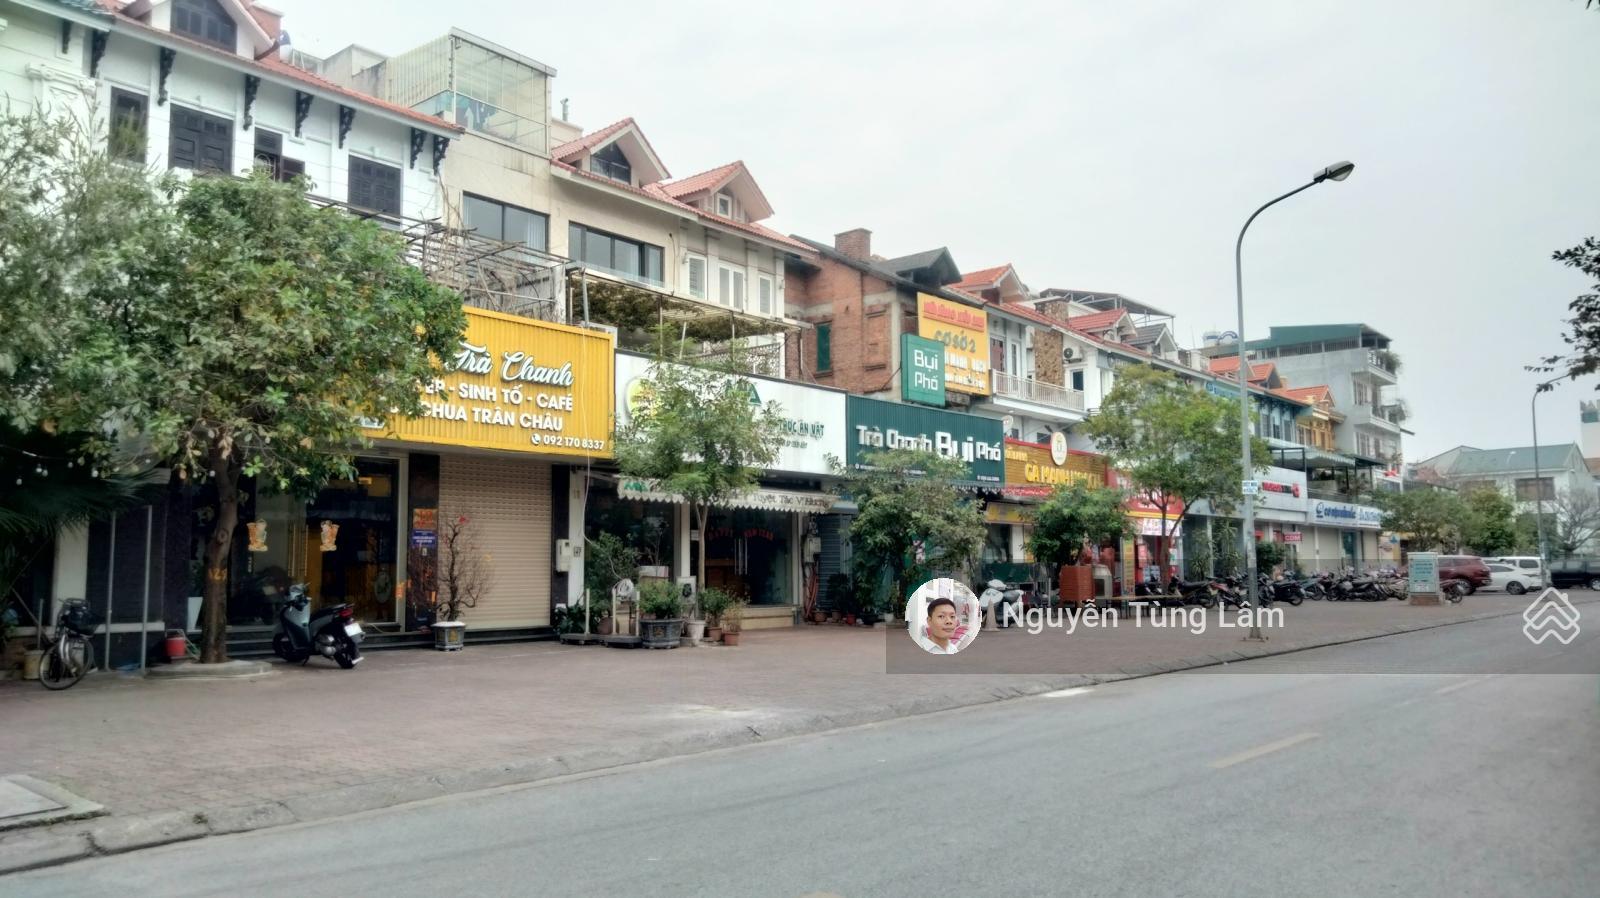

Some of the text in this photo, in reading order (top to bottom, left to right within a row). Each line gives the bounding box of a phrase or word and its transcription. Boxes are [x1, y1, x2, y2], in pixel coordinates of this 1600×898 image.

[501, 351, 575, 387] Chanh
[914, 349, 938, 372] Bụi
[914, 375, 938, 391] Phố
[458, 382, 497, 402] SINH
[501, 384, 523, 405] TỐ
[536, 393, 573, 412] CAFÉ
[471, 407, 515, 427] TRÂN
[519, 411, 563, 431] CHÂU
[543, 434, 605, 450] 092 170 8337
[856, 425, 883, 447] Trà
[976, 440, 1001, 462] Phố
